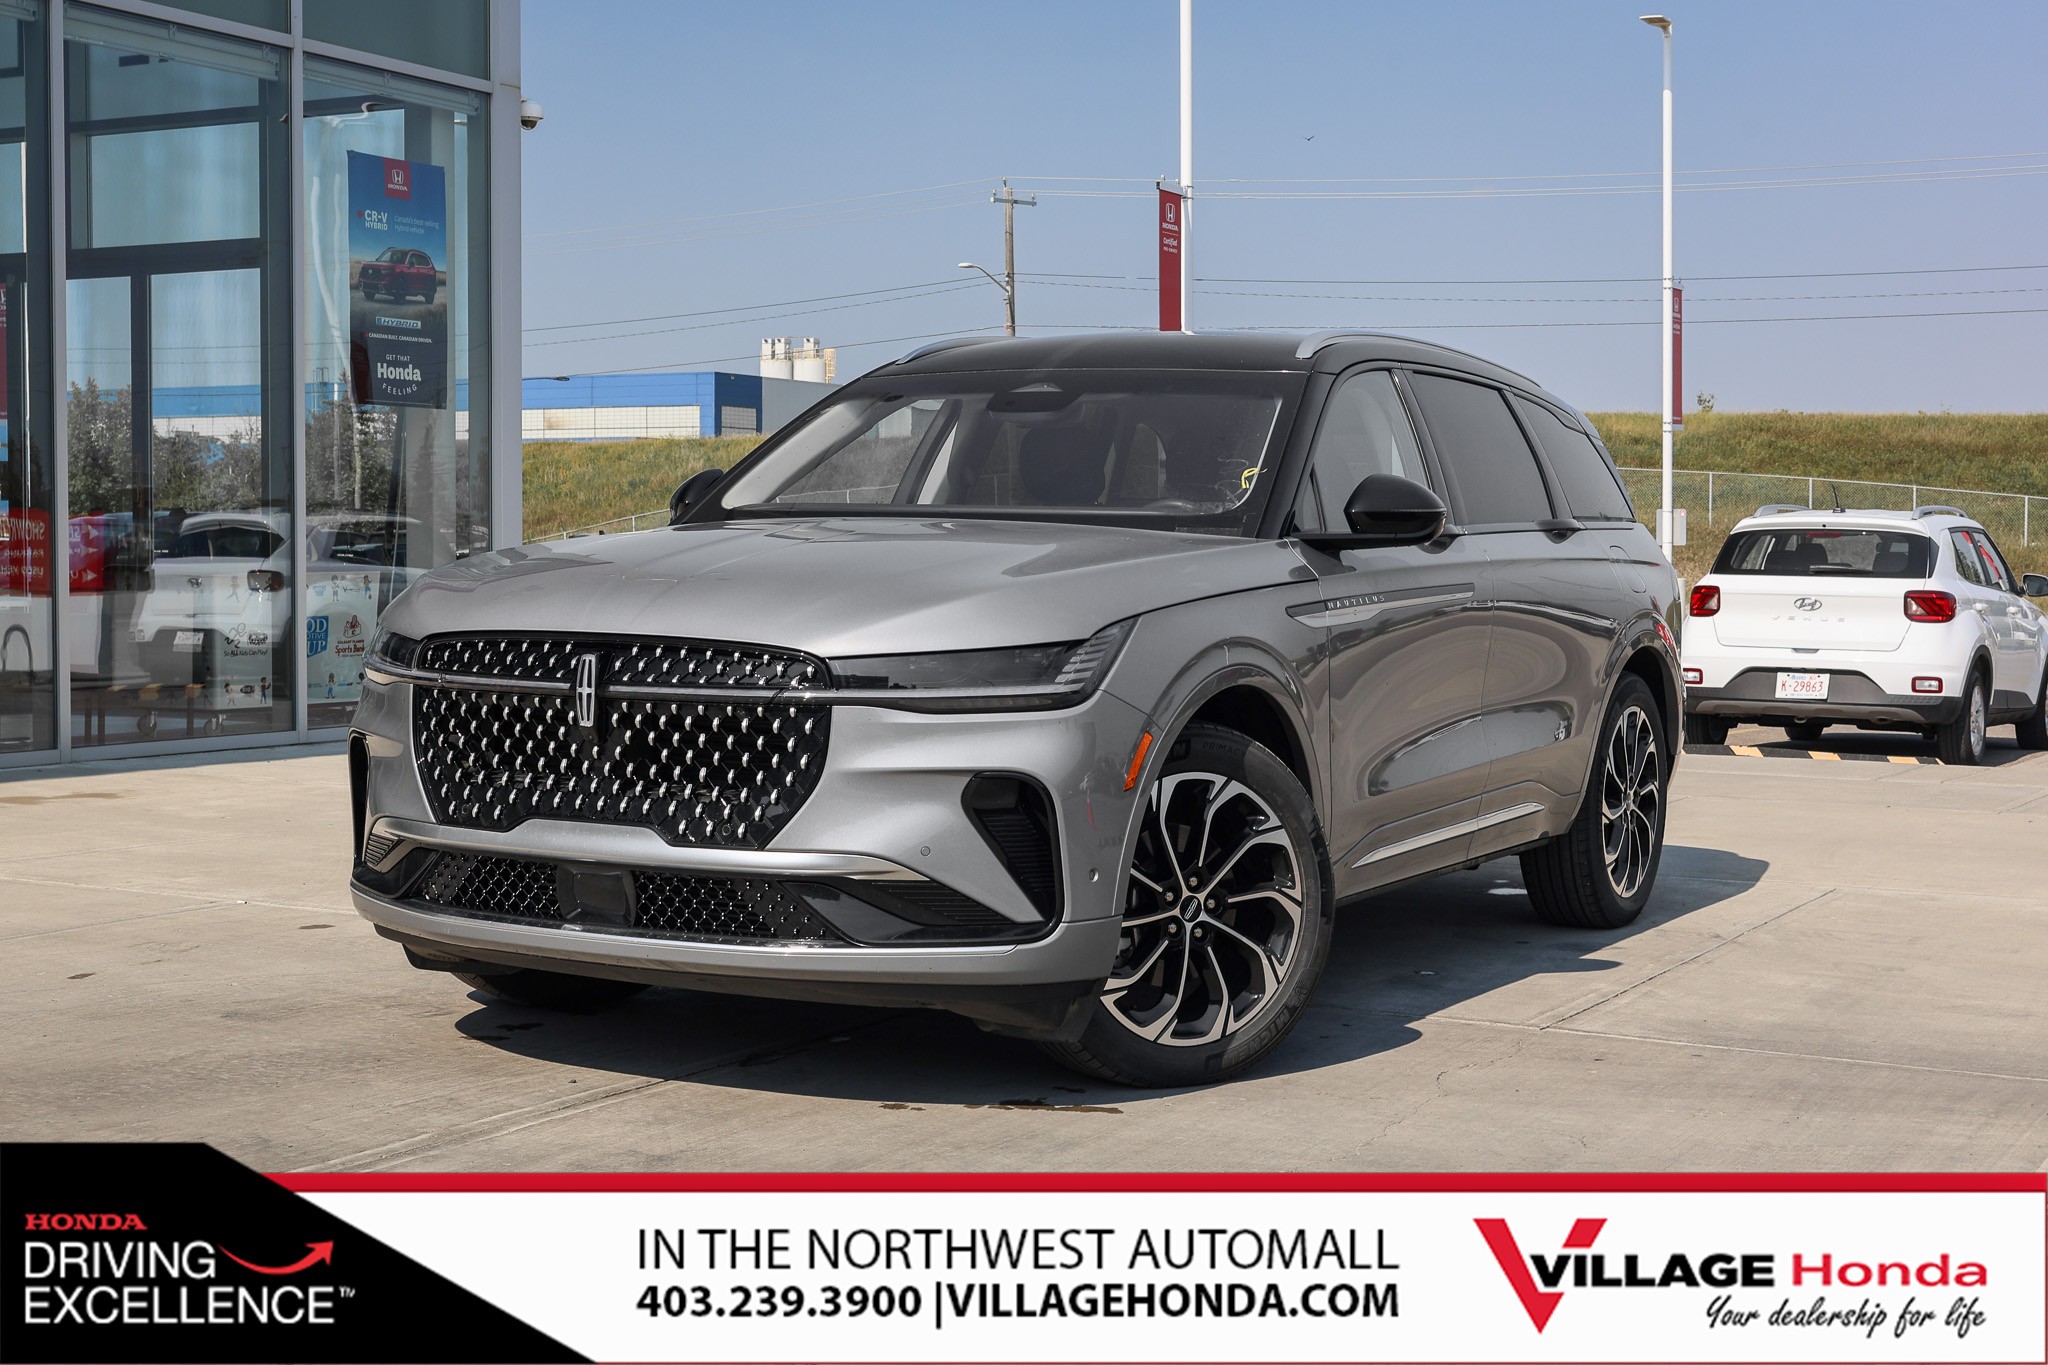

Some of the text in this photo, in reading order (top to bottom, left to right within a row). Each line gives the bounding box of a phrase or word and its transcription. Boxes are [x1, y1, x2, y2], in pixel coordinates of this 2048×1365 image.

[387, 183, 408, 192] HONDA
[364, 209, 388, 223] CR-V
[365, 220, 388, 231] HYBRID
[1162, 222, 1179, 231] HONDA
[382, 318, 419, 328] HYBRID
[368, 332, 388, 340] CANADIAN
[398, 335, 419, 343] CANADIAN
[377, 362, 422, 382] Honda
[382, 382, 418, 396] FEELING
[1327, 594, 1385, 609] NAUTILUS
[335, 645, 353, 656] Sports
